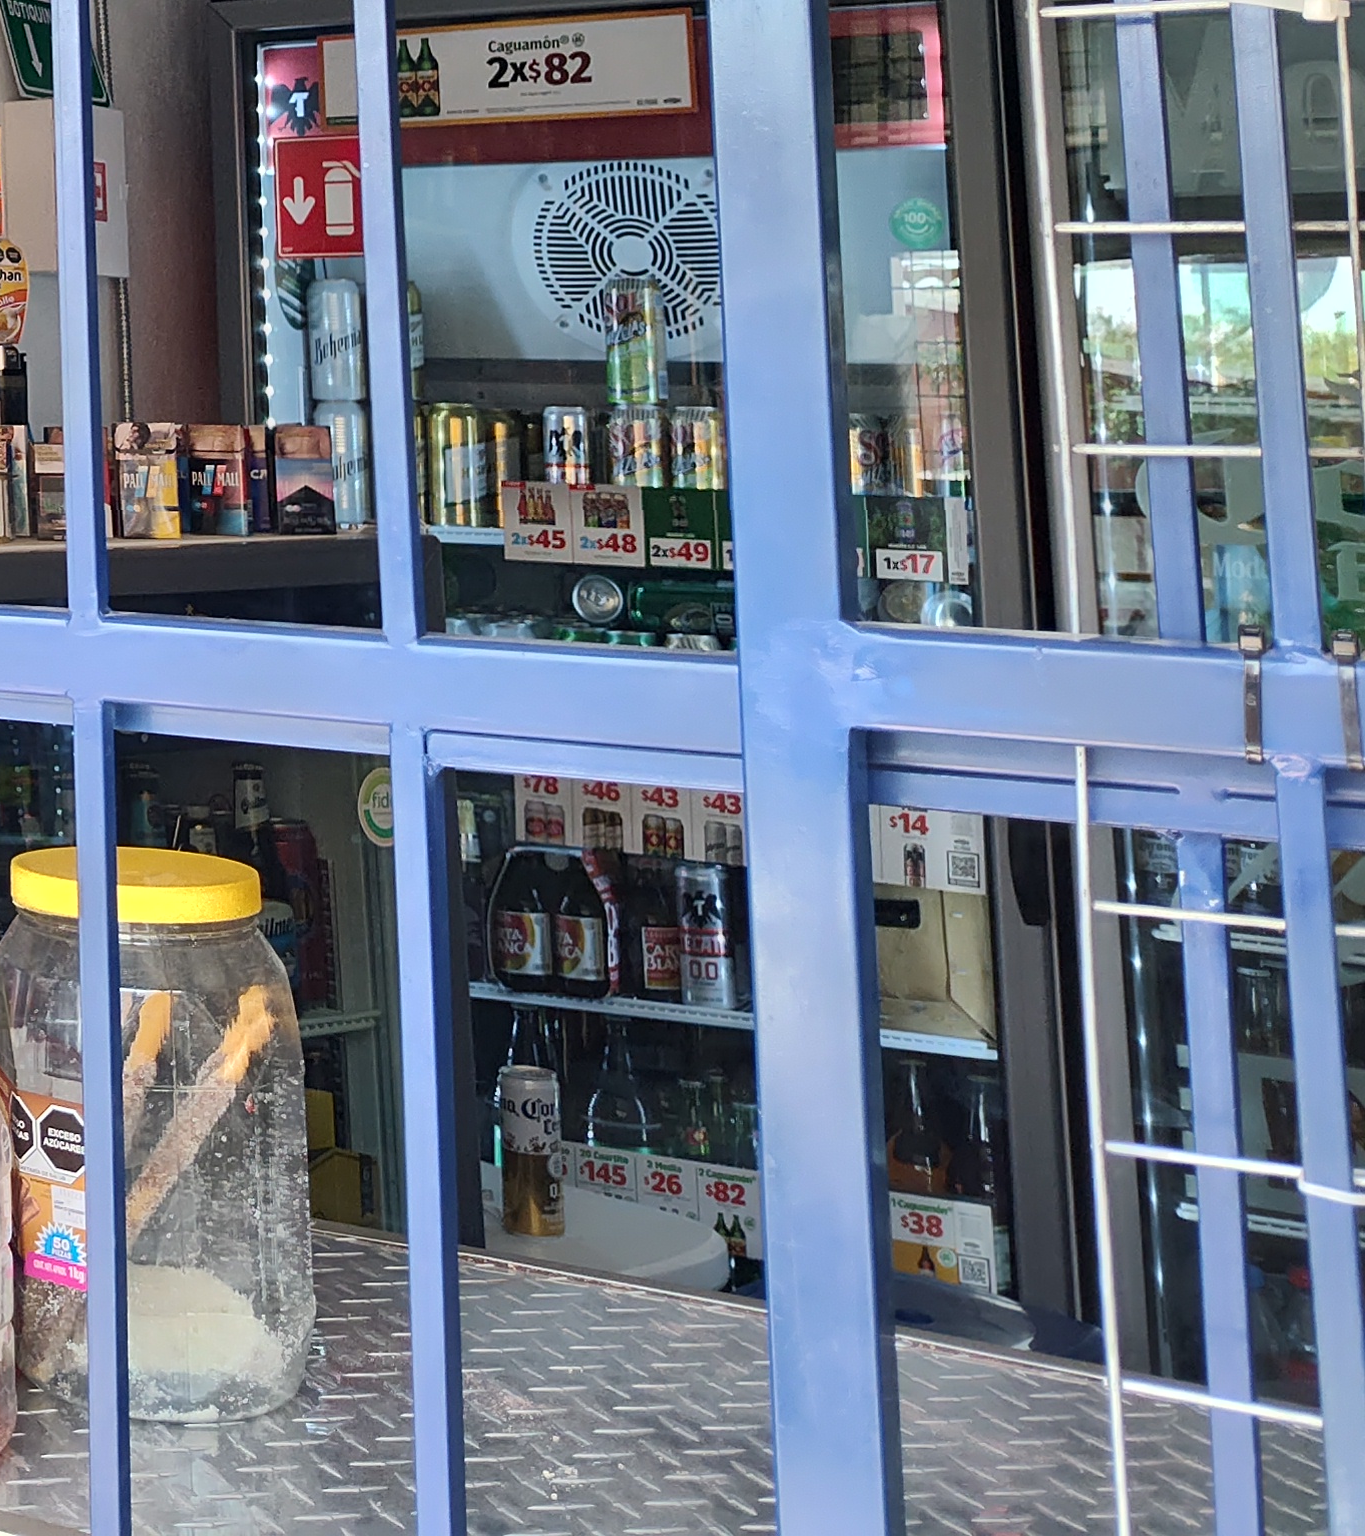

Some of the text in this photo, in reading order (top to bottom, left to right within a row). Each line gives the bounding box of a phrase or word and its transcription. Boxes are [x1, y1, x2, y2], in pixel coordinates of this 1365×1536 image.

[191, 471, 212, 487] PALL
[217, 471, 240, 487] MALL
[883, 553, 935, 575] 1x$17
[524, 775, 559, 795] $78
[582, 781, 621, 802] $46
[641, 787, 679, 809] $43
[703, 793, 742, 815] $43
[889, 812, 930, 836] $14
[47, 1127, 82, 1143] EXCESO
[579, 1159, 627, 1186] $145
[644, 1171, 683, 1196] $26
[705, 1181, 747, 1207] $82
[900, 1211, 944, 1238] $38
[52, 1236, 70, 1252] 50
